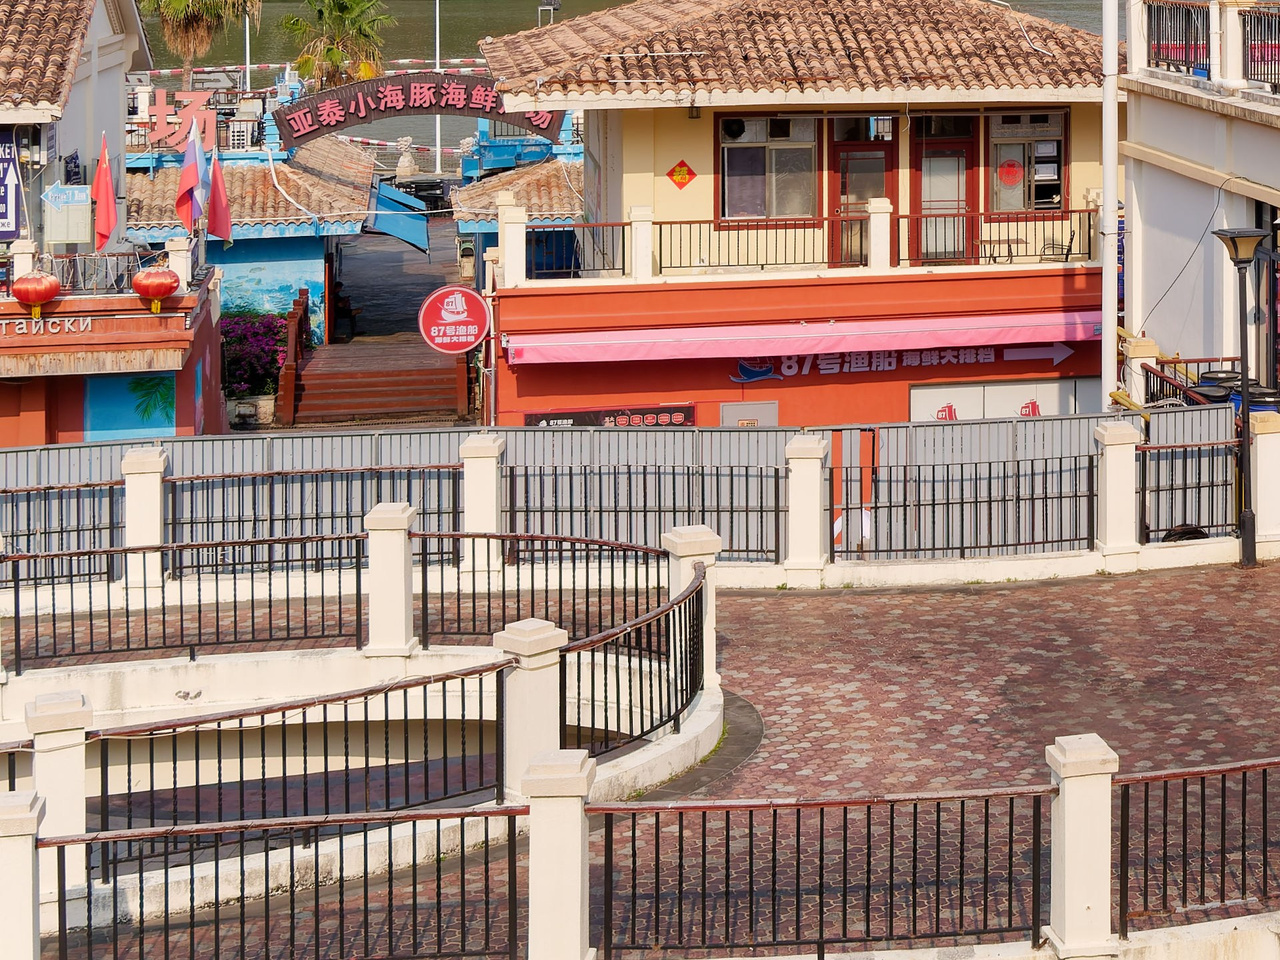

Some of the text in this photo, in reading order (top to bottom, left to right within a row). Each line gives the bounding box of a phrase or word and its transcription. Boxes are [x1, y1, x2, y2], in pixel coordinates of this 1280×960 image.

[148, 89, 217, 153] 场
[285, 82, 553, 138] 亚泰小海豚海鲜场
[430, 325, 478, 336] 87号渔船
[902, 347, 995, 366] 海鲜大排档
